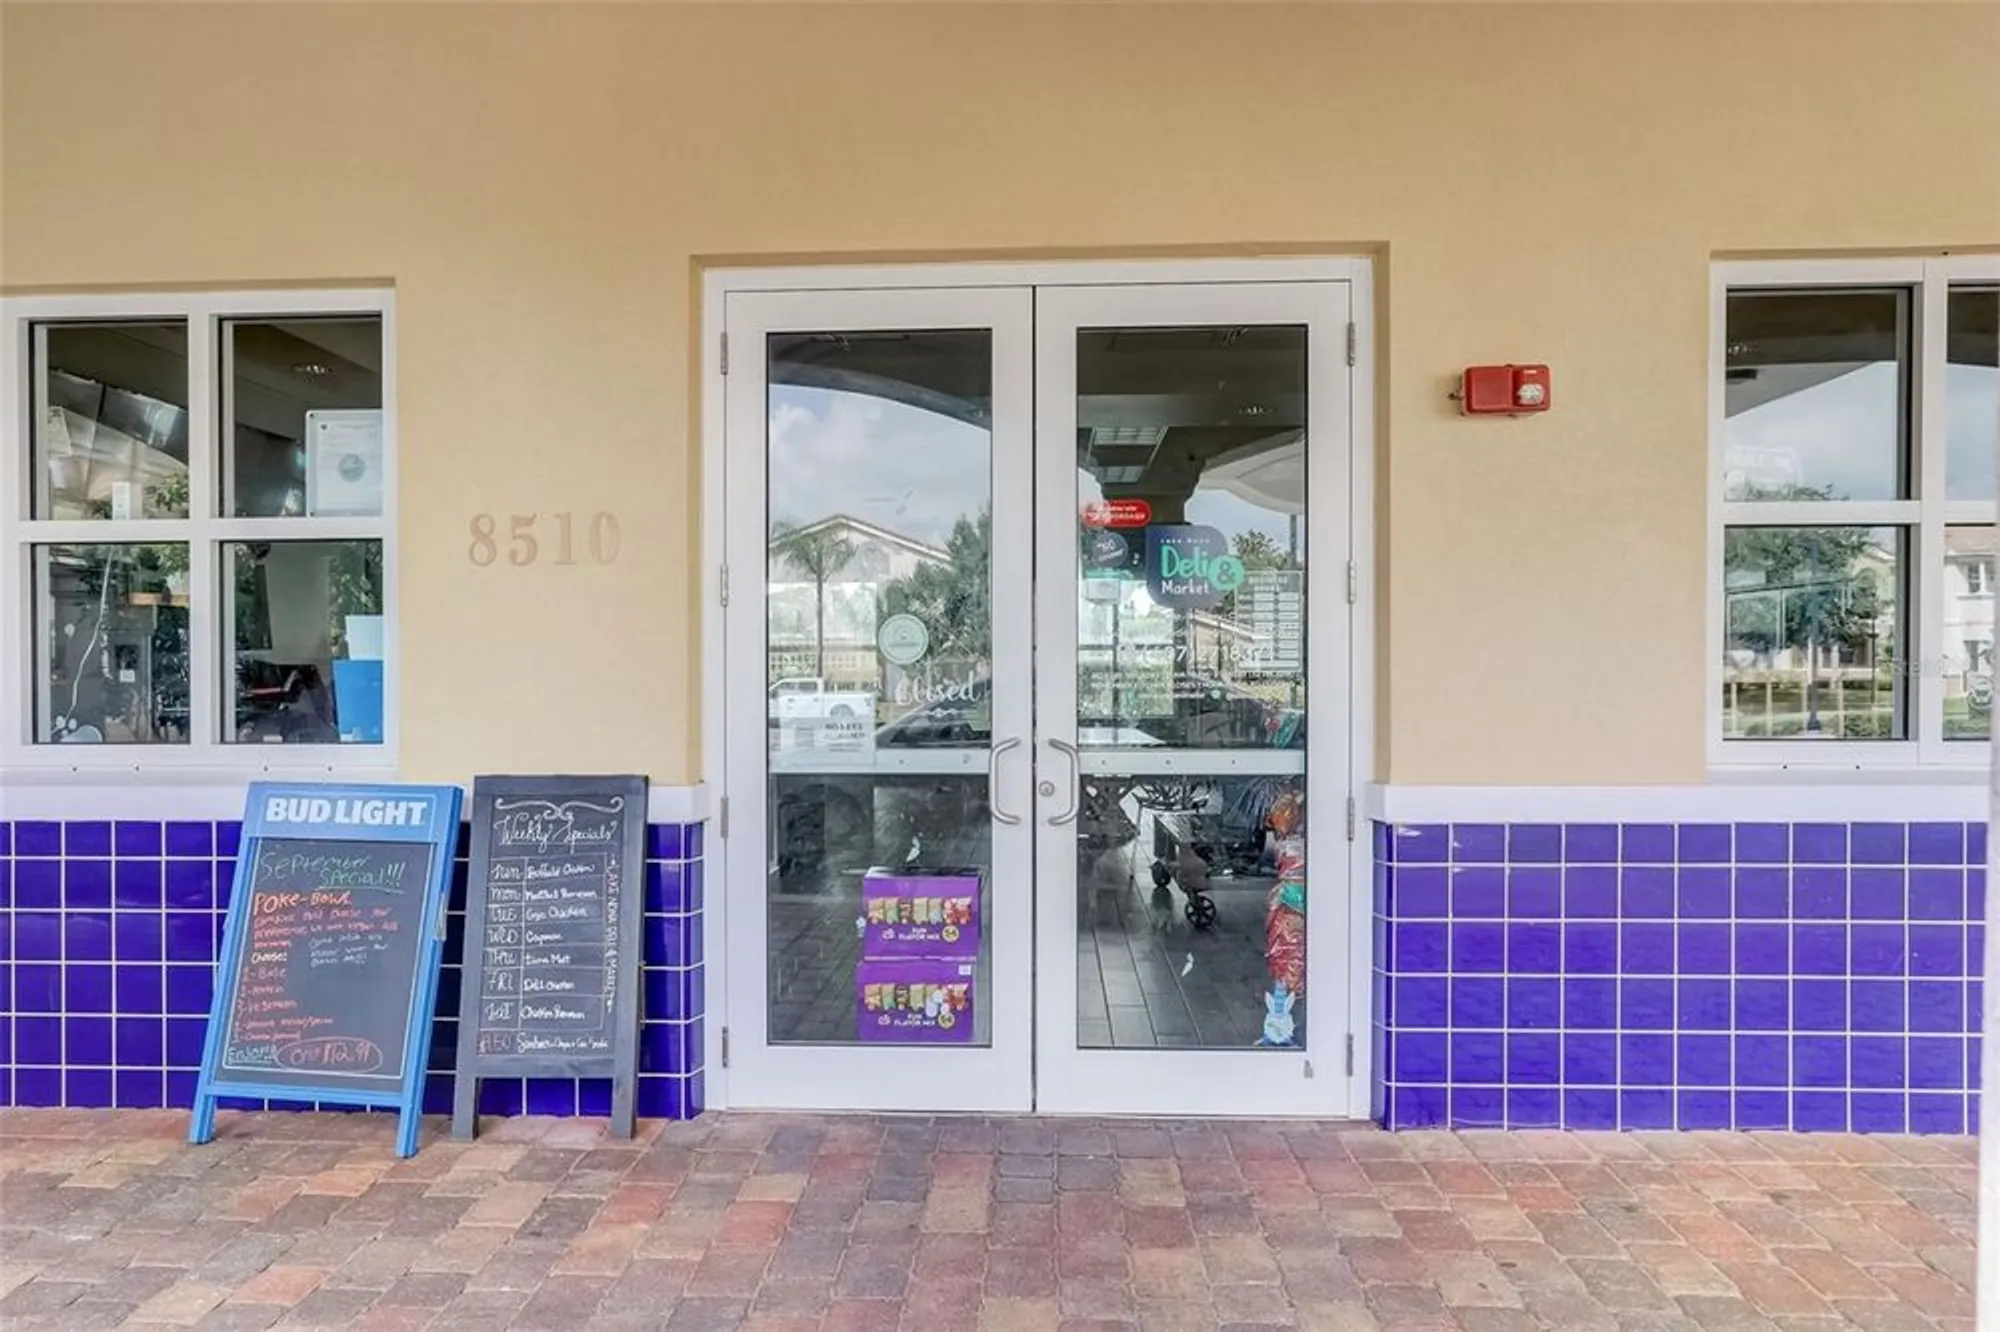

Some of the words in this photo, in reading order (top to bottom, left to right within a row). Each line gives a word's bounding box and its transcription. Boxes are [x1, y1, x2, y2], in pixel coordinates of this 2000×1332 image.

[469, 512, 621, 567] 8510
[1161, 545, 1209, 577] Deli
[1216, 561, 1233, 585] &
[1161, 580, 1209, 596] Market
[265, 797, 332, 824] BUD
[335, 799, 427, 826] LIGHT
